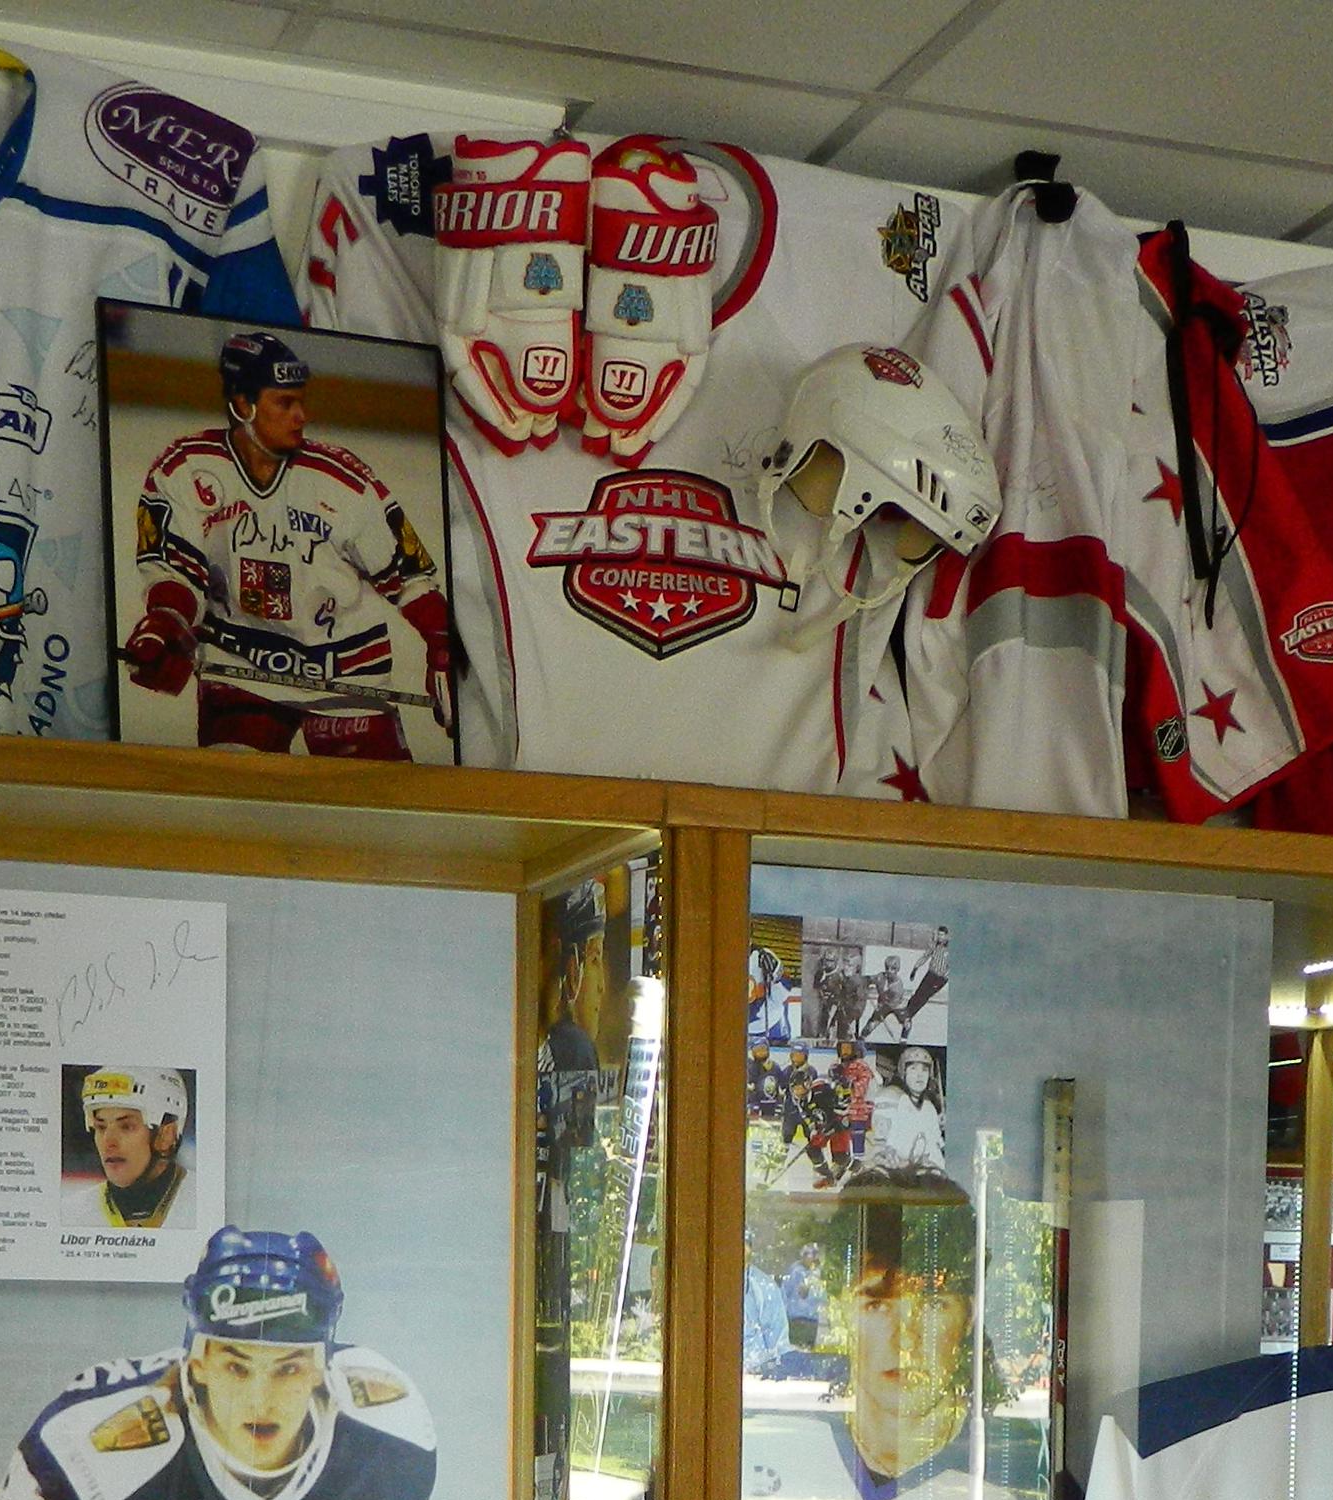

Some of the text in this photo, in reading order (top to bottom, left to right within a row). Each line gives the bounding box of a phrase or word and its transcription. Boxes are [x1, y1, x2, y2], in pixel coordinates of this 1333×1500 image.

[386, 166, 397, 204] LEAFS
[398, 163, 409, 205] MAPLE
[408, 152, 421, 217] TORONTO
[617, 487, 713, 516] NHL
[533, 512, 786, 581] EASTERN
[589, 566, 732, 597] CONFERENCE
[59, 1233, 157, 1248] Libor Procházka
